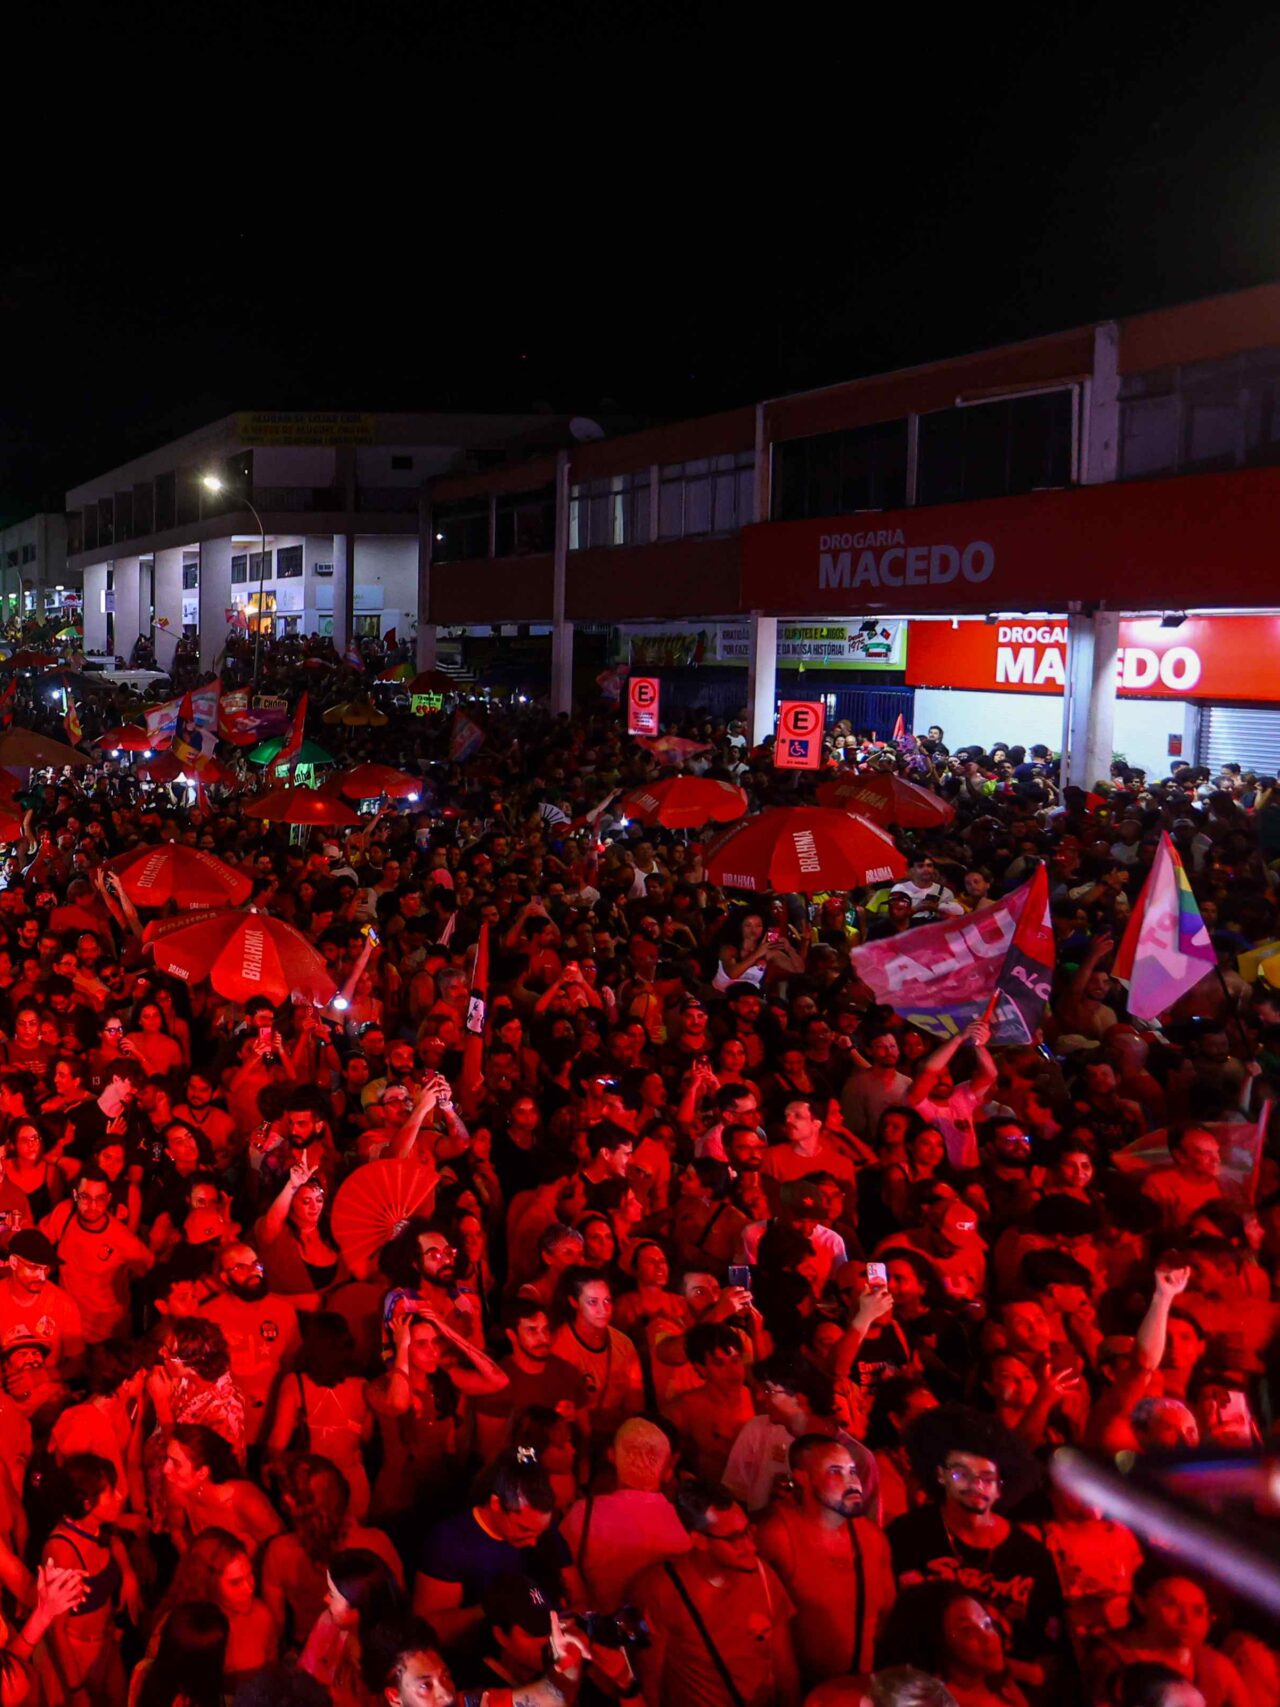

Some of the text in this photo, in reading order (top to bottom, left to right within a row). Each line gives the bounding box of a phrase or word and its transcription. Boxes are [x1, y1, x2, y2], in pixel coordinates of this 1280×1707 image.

[820, 529, 905, 550] DROGARIA
[819, 541, 995, 589] MACEDO
[996, 646, 1201, 690] MADO
[638, 685, 649, 702] E
[793, 711, 809, 730] E
[793, 829, 820, 873] BRAHMA
[722, 872, 756, 890] BRAHMA
[865, 866, 894, 883] BRAHMA
[242, 929, 264, 981] BRAHMA
[92, 1076, 101, 1085] 13
